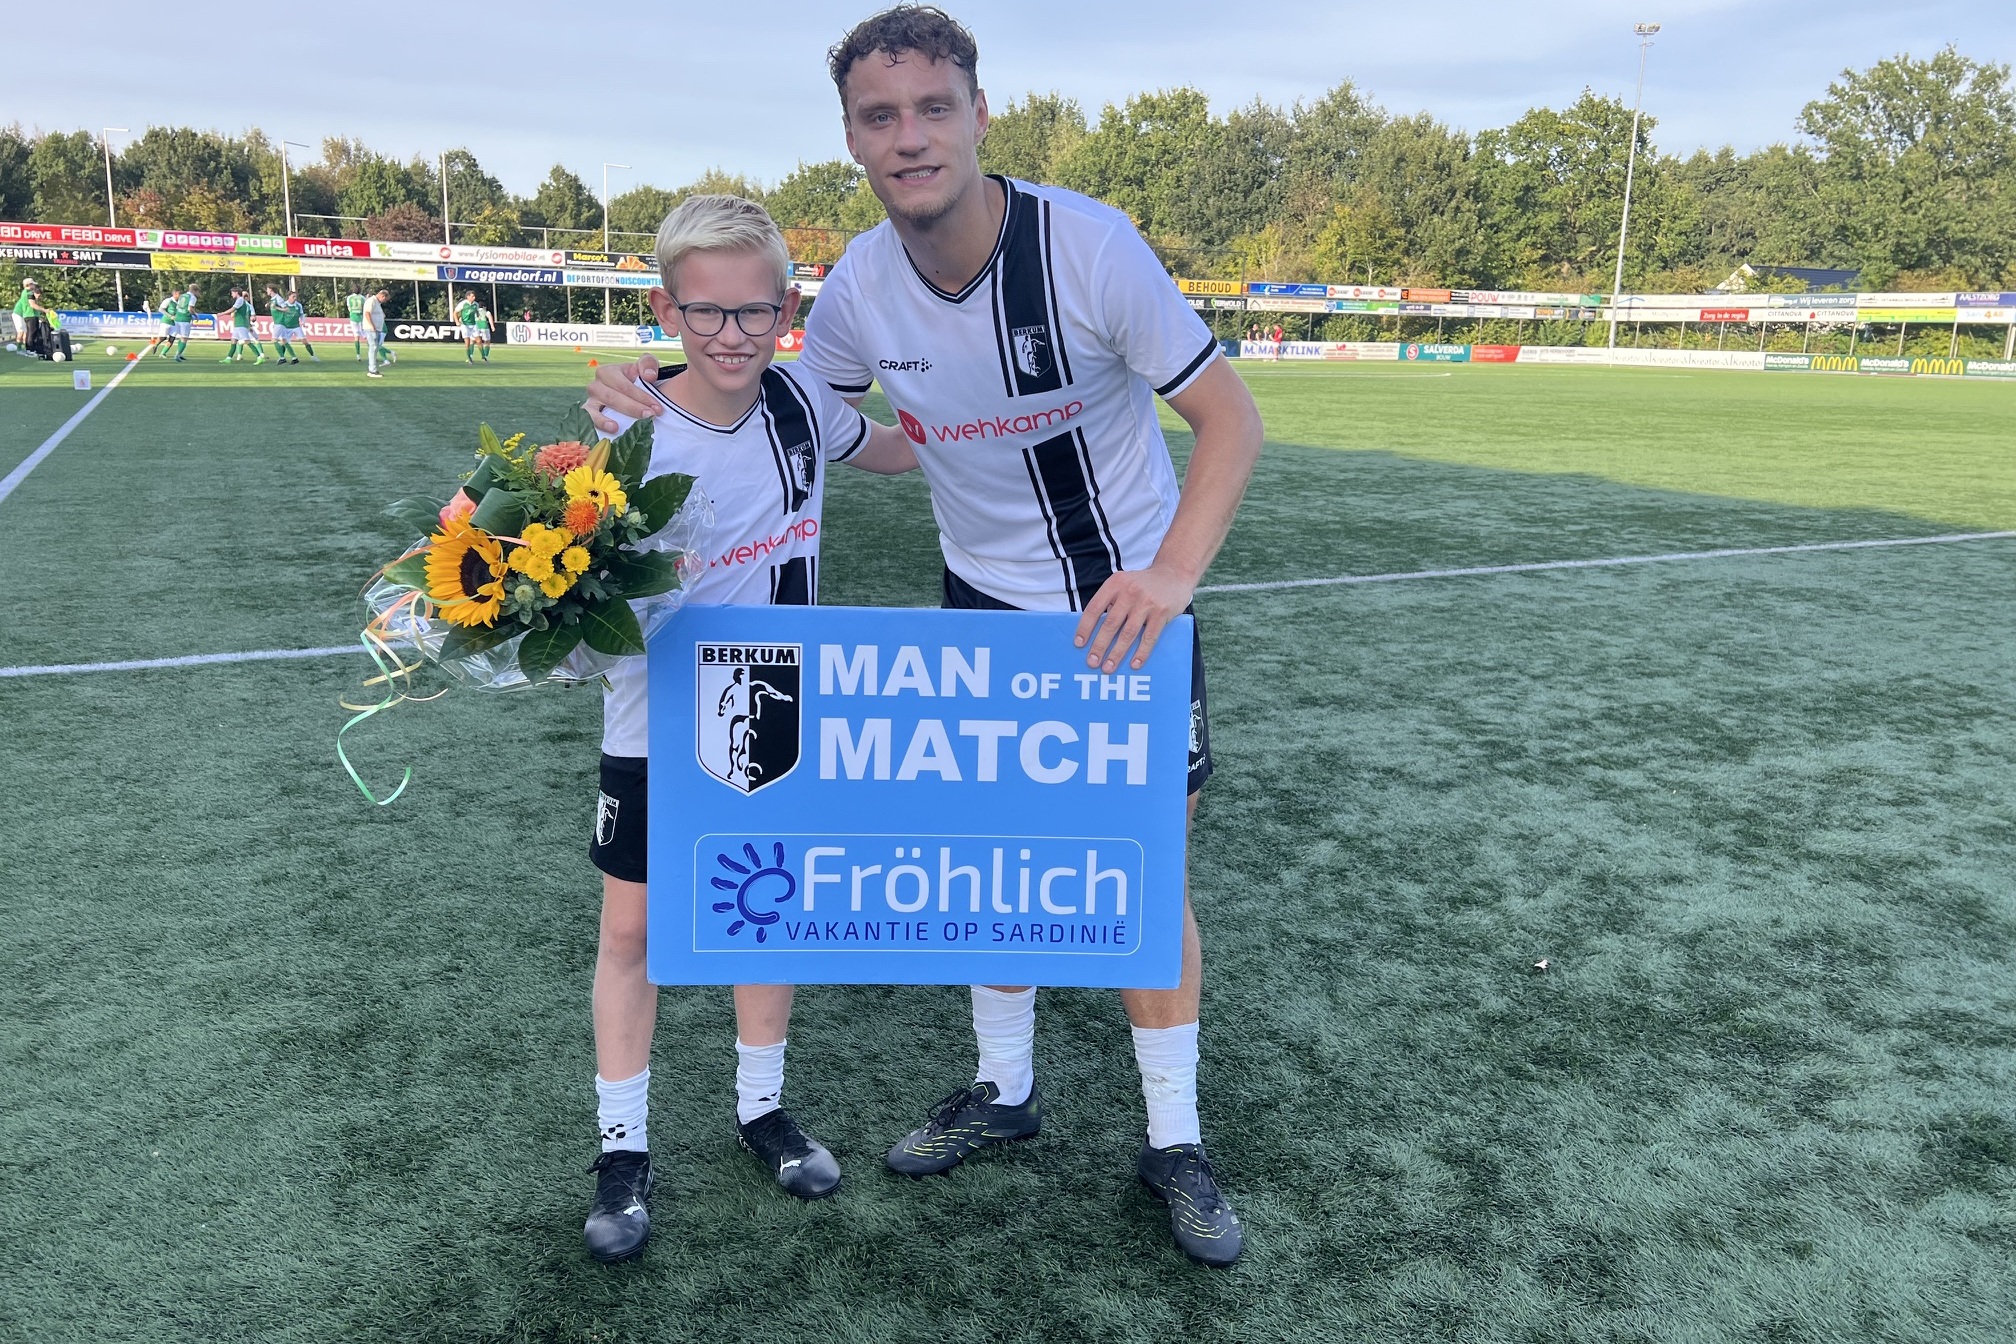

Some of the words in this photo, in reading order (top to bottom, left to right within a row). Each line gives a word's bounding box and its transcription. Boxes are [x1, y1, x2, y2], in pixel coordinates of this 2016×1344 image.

[24, 230, 52, 239] DRIVE
[61, 229, 103, 242] FEBO
[105, 234, 132, 243] DRIVE
[0, 248, 58, 259] KENNETH
[72, 250, 103, 261] SMIT
[304, 240, 353, 256] unica
[573, 253, 608, 262] Marco's
[465, 269, 557, 283] roggendorf.nl
[1188, 281, 1232, 293] BEHOUD
[1470, 291, 1500, 303] POUW
[1812, 296, 1838, 304] leveren
[1839, 297, 1856, 306] zorg
[58, 313, 99, 324] Premio
[102, 314, 124, 325] Van
[127, 315, 160, 326] Essen
[303, 323, 355, 337] REIZE
[394, 324, 462, 340] CRAFT
[538, 328, 589, 342] Hekon
[1013, 326, 1045, 337] BERKUM
[1258, 345, 1321, 356] MARKTLINK
[1423, 345, 1465, 355] SALVERDA
[879, 359, 920, 372] CRAFT
[1766, 355, 1809, 365] McDonald's
[1861, 358, 1910, 368] McDonald's
[931, 401, 1083, 442] wehkamp
[702, 647, 796, 664] BERKUM
[819, 644, 991, 698] MAN
[1011, 672, 1062, 699] OF
[1074, 673, 1151, 701] THE
[819, 717, 1149, 786] MATCH
[803, 846, 1128, 916] Fröhlich
[786, 921, 929, 942] VAKANTIE
[943, 922, 978, 942] OP
[992, 920, 1126, 945] SARDINIË
